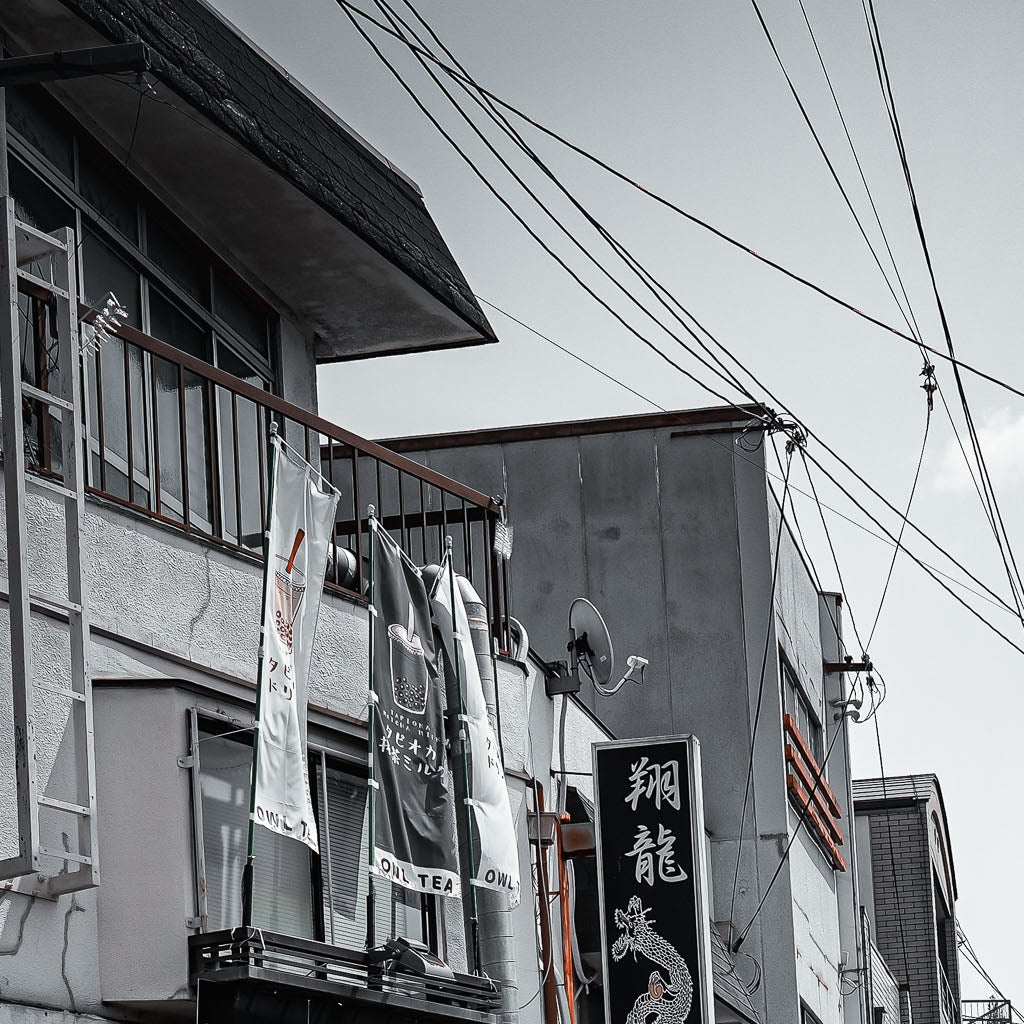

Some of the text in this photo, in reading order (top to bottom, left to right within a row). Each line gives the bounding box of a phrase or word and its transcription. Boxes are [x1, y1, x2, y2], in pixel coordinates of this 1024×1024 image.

[386, 724, 437, 760] タピオカ
[624, 756, 688, 886] 翔龍
[380, 857, 453, 894] OWL TEA
[485, 869, 513, 890] OWL
